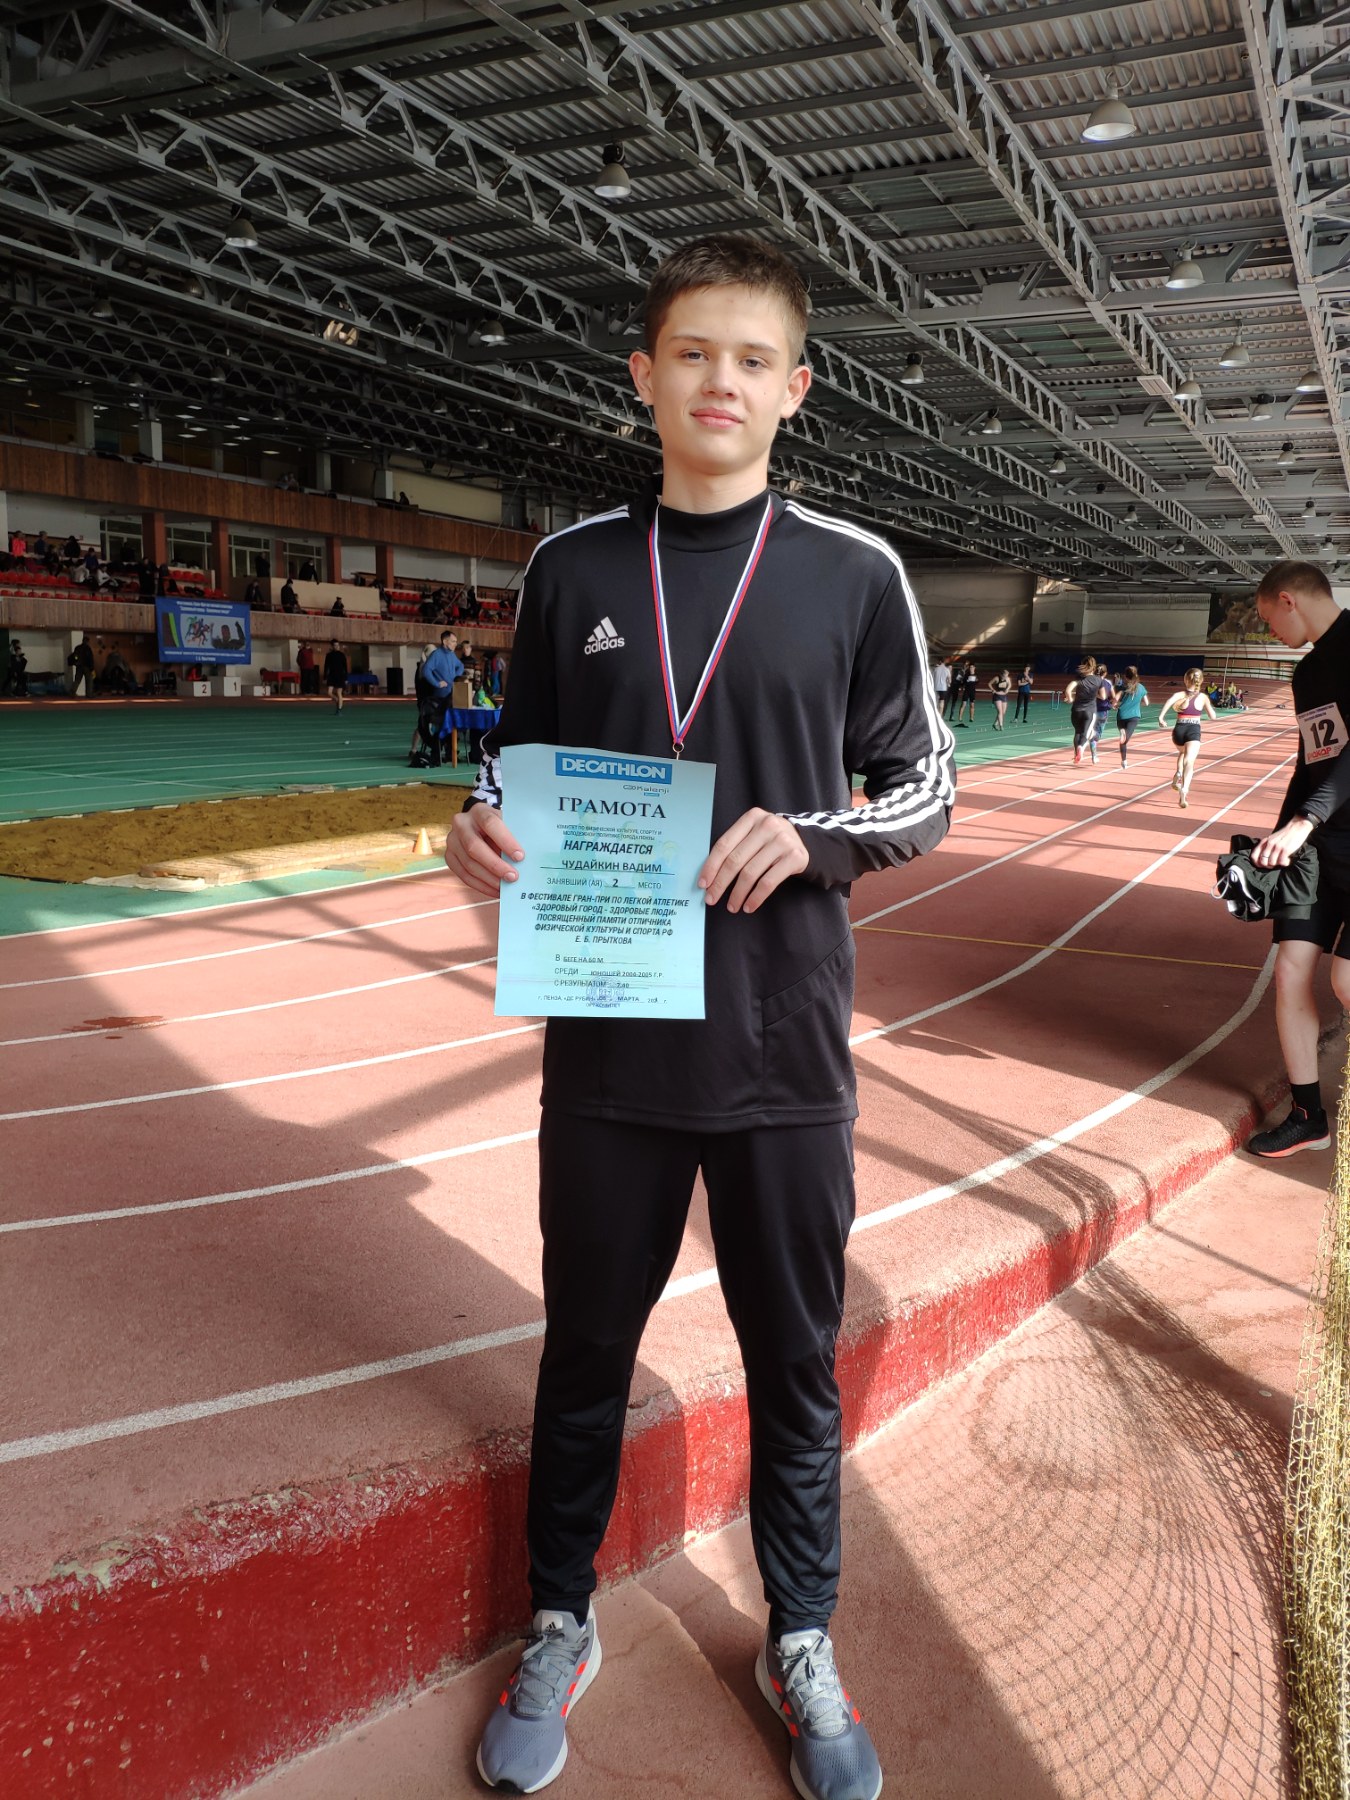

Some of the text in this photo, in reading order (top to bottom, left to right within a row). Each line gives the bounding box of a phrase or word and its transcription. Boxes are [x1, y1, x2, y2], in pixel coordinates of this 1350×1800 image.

[584, 637, 625, 655] adidas
[202, 684, 207, 693] 2
[1310, 719, 1339, 749] 12
[562, 758, 666, 779] DECATHLON
[558, 796, 667, 819] ГРАМОТА
[563, 840, 654, 855] НАГРАЖДАЕТСЯ
[562, 859, 662, 873] ЧУДАЙКИН ВАДИМ
[546, 878, 662, 890] ЗАНЯВШИЙ (АЯ) 2 МЕСТО
[520, 892, 690, 907] В ФЕСТИВАЛЕ ГРАН-ПРИ ПО ЛЕГКОЙ АТЛЕТИКЕ
[532, 903, 577, 912] «ЗДОРОВЫЙ
[579, 905, 603, 914] ГОРОД
[609, 907, 650, 915] ЗДОРОВЫЕ
[537, 913, 672, 926] ПОСВЯЩЕННЫЙ ПАМЯТИ ОТЛИЧНИКА
[534, 923, 585, 932] ФИЗИЧЕСКОЙ
[585, 925, 624, 934] КУЛЬТУРЫ
[632, 927, 660, 936] СПОРТА
[593, 936, 632, 945] ПРЫТКОВА
[554, 967, 579, 976] СРЕДИ
[554, 979, 560, 987] С
